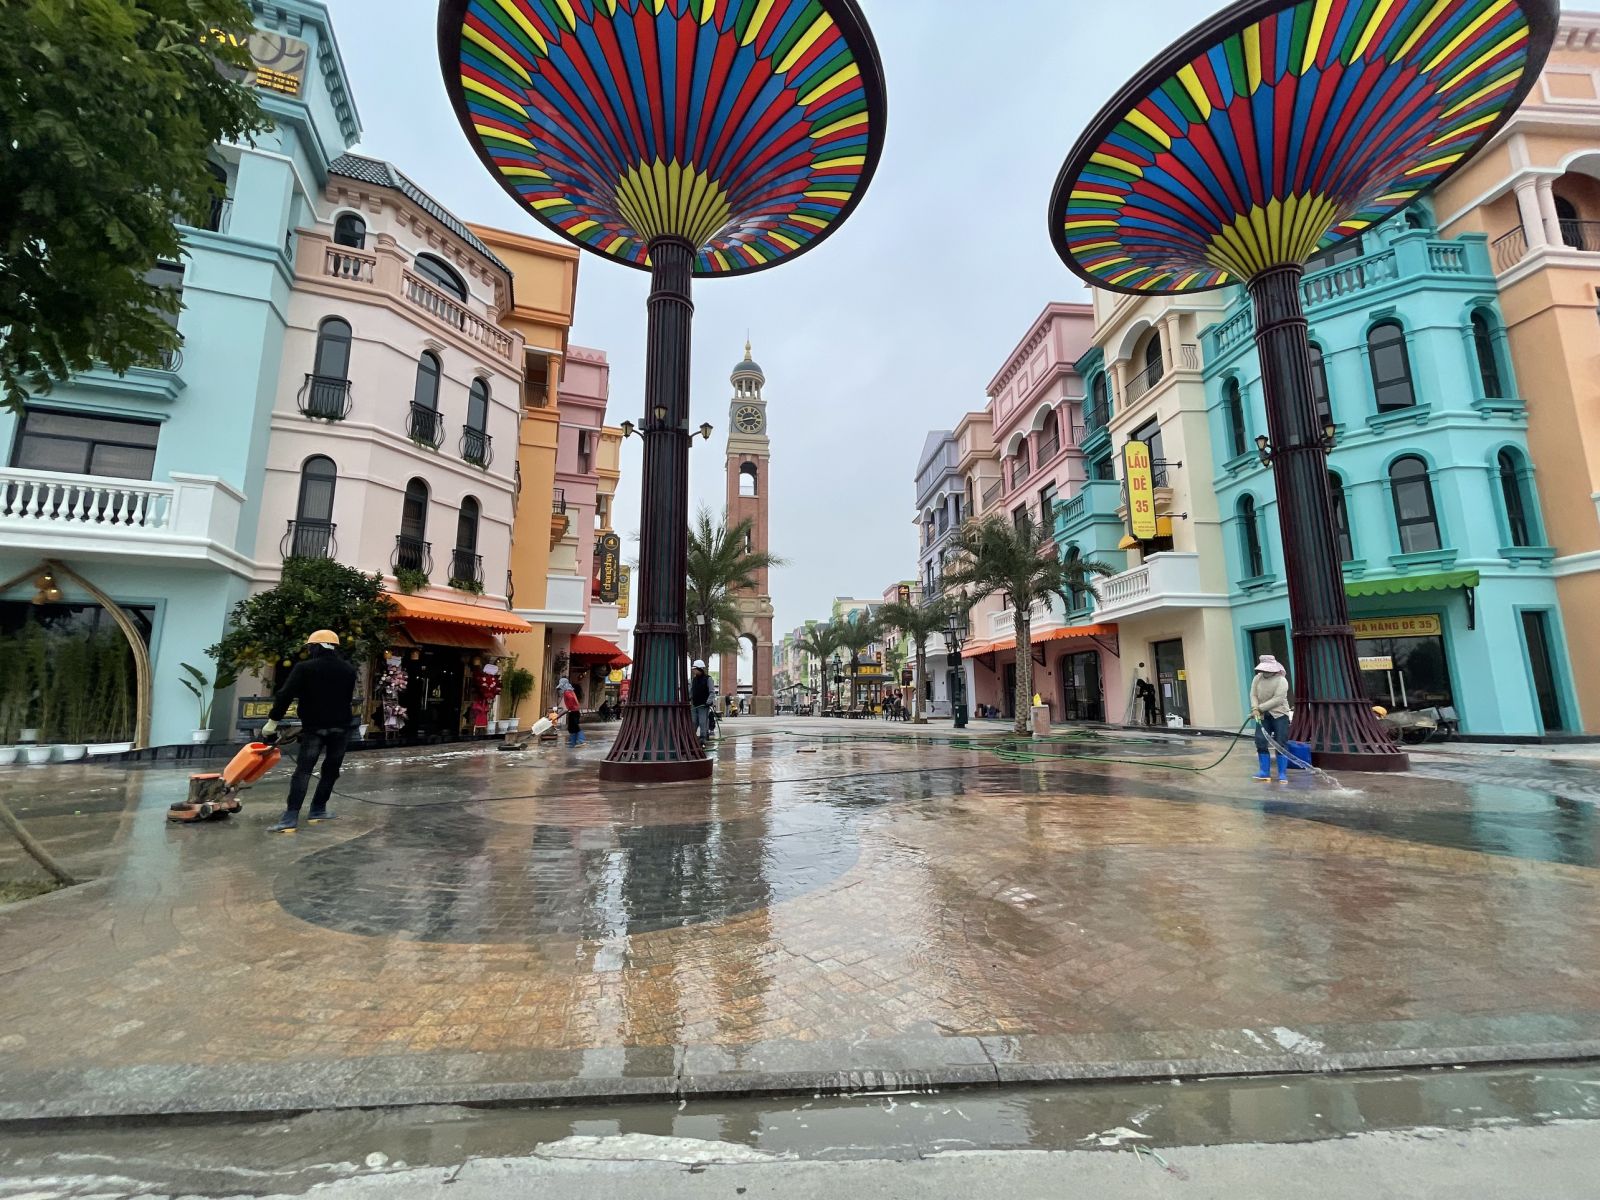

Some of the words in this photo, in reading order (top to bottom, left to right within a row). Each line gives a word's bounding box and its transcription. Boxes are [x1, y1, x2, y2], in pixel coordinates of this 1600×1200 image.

[1133, 475, 1147, 490] DÊ
[1135, 500, 1149, 513] 35
[1418, 620, 1432, 629] 35
